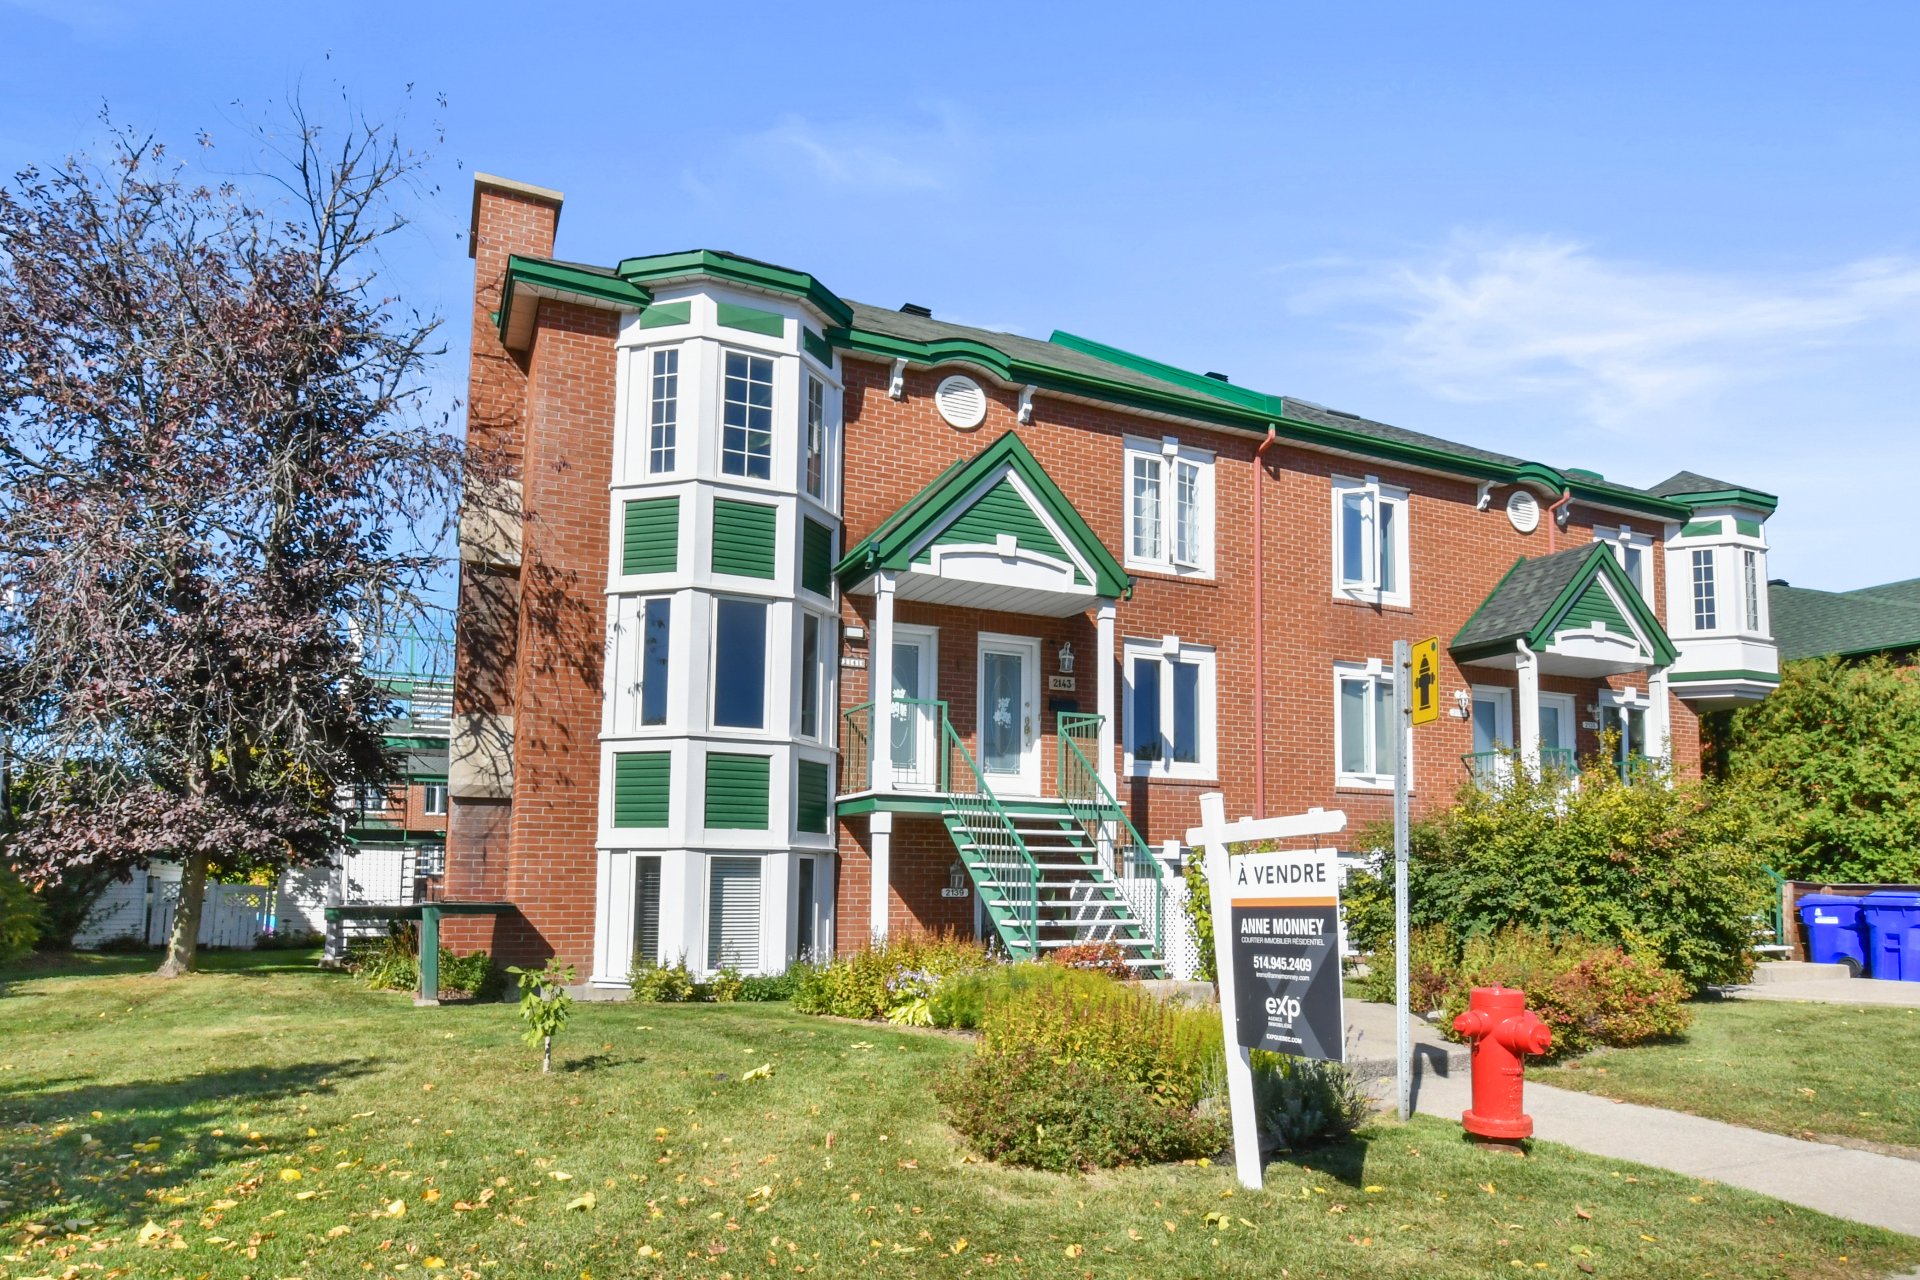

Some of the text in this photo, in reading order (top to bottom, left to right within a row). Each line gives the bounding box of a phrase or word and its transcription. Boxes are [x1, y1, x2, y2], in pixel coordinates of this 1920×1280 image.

[1053, 679, 1072, 688] 2143
[1238, 862, 1326, 885] À VENDRE
[945, 889, 965, 897] 2139
[1241, 918, 1324, 936] ANNE MONNEY
[1292, 937, 1325, 946] RÉSIDENTIEL
[1253, 955, 1312, 972] 514.945.2409
[1265, 995, 1300, 1023] exp
